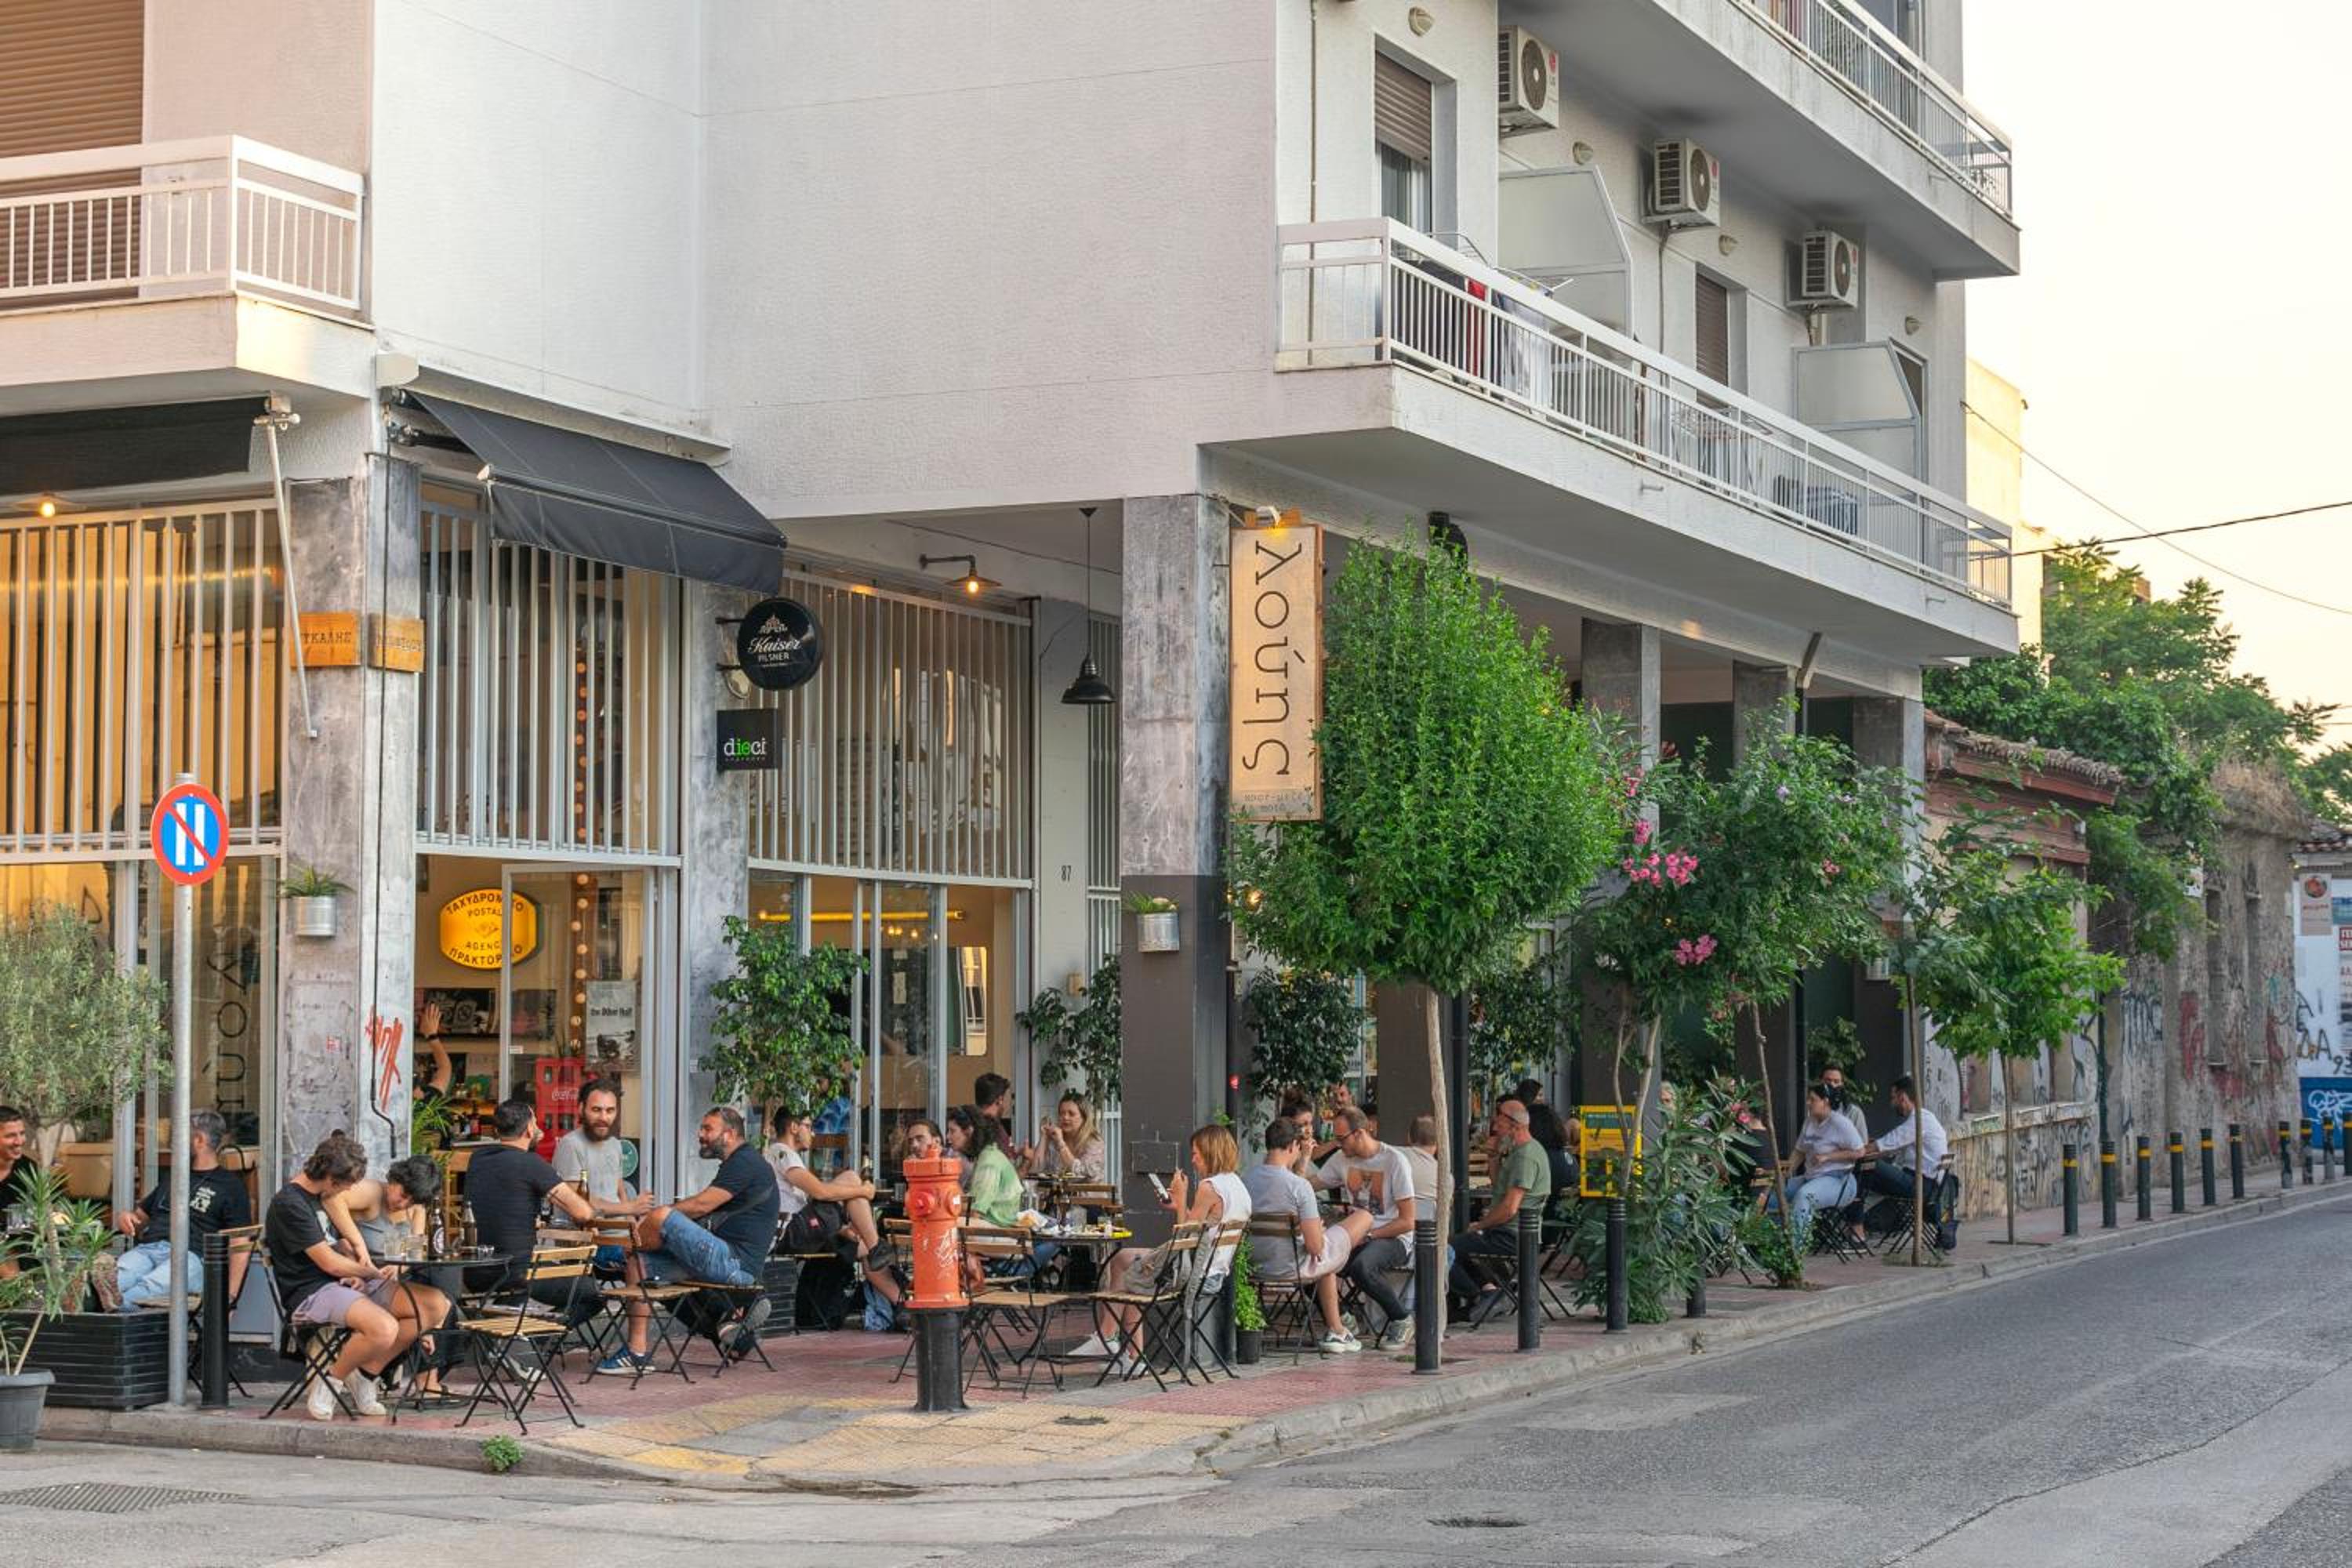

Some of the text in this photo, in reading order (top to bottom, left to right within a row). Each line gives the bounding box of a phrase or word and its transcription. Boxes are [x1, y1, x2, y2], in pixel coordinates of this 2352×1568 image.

[748, 636, 801, 652] Kaiser
[757, 652, 790, 662] PILSNER
[724, 737, 767, 757] dieci
[1061, 865, 1072, 882] 87
[466, 941, 500, 951] AGENC
[449, 943, 524, 966] ΠΡΑΚΤΟΡΟ
